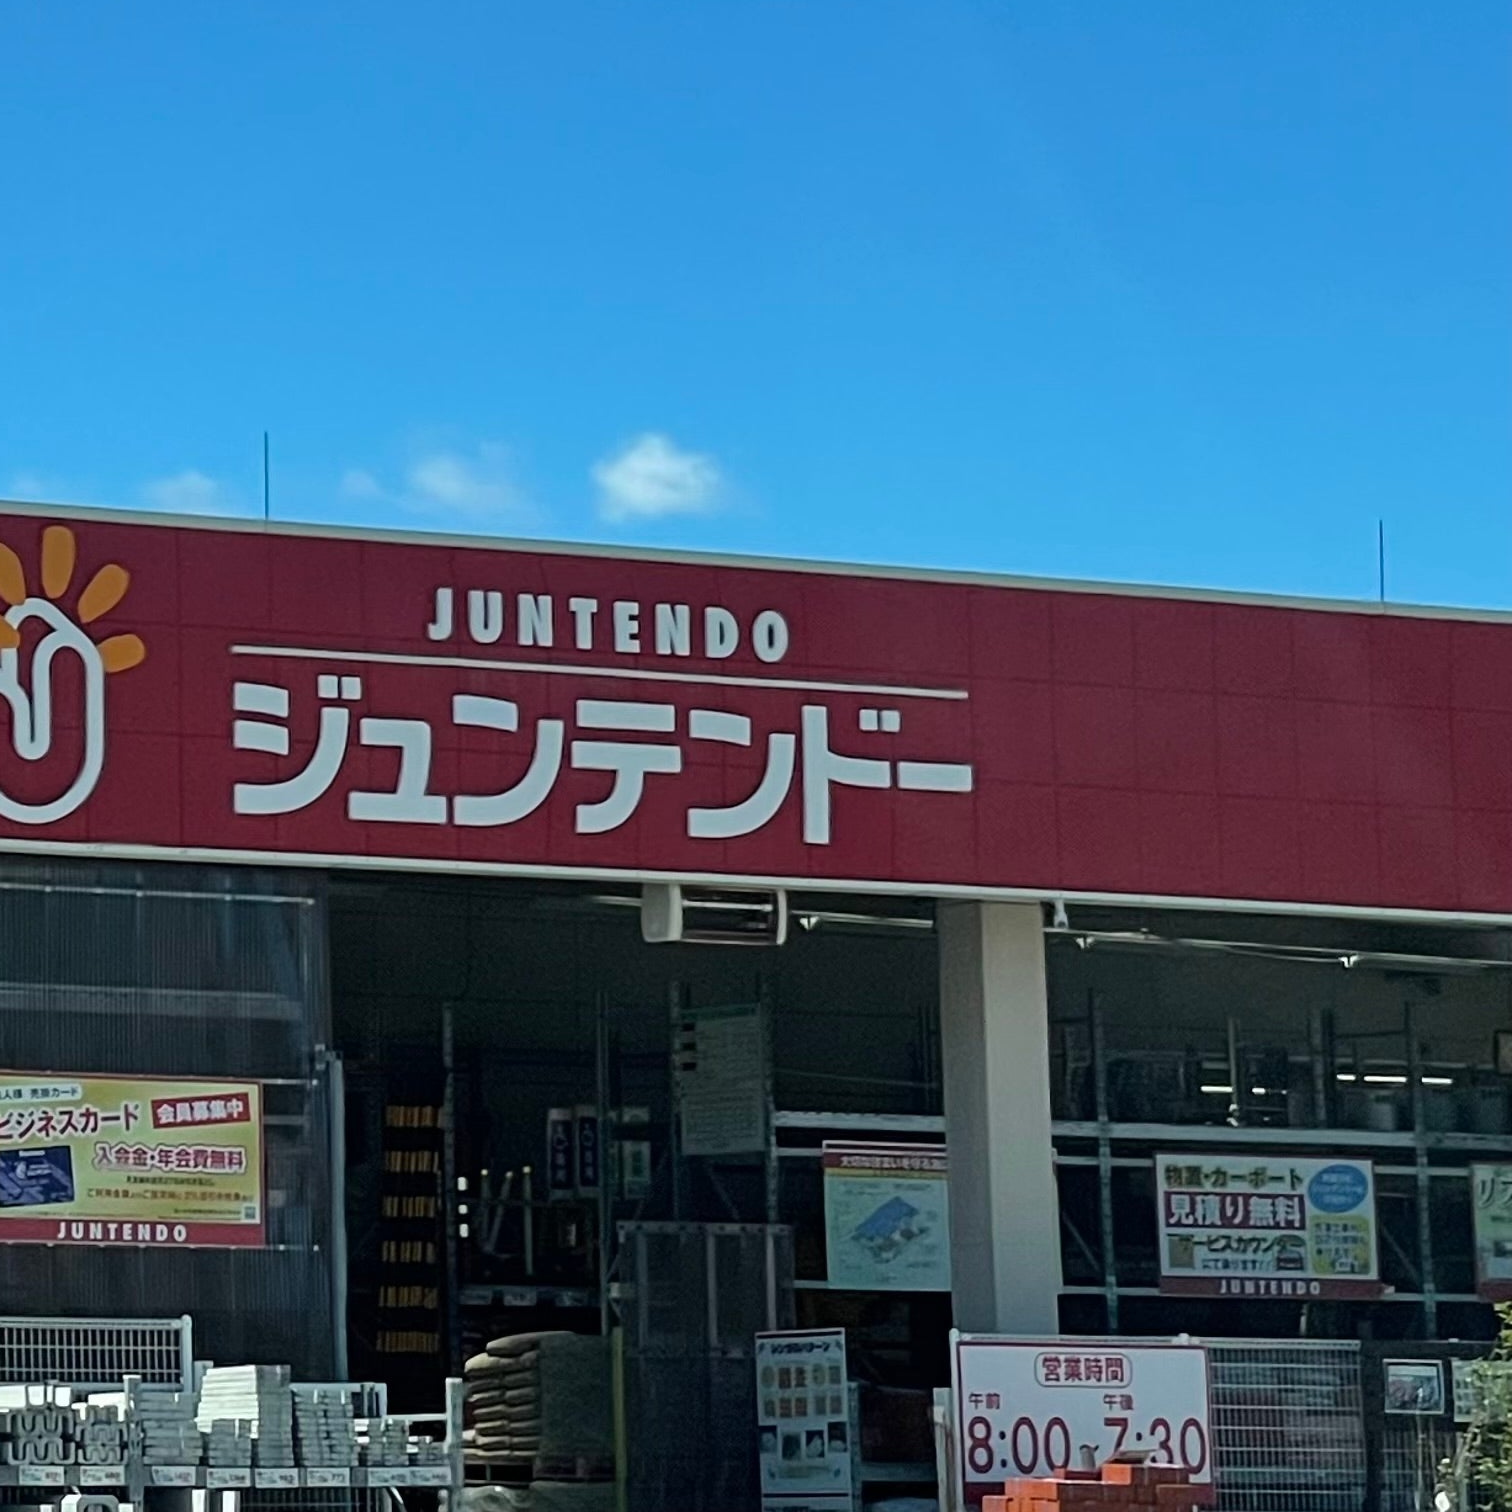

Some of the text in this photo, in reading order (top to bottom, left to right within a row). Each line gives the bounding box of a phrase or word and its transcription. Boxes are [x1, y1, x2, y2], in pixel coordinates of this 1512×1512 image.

[428, 588, 789, 663] JUNTENDO
[233, 675, 972, 844] ジュンテンドー
[1169, 1194, 1301, 1227] 見積り無料
[57, 1222, 187, 1242] JUNTENDO
[1220, 1280, 1320, 1295] JUNTENDO
[1042, 1356, 1125, 1382] 営業時間
[968, 1392, 1135, 1410] 午前 午後
[968, 1415, 1071, 1474] 8:00
